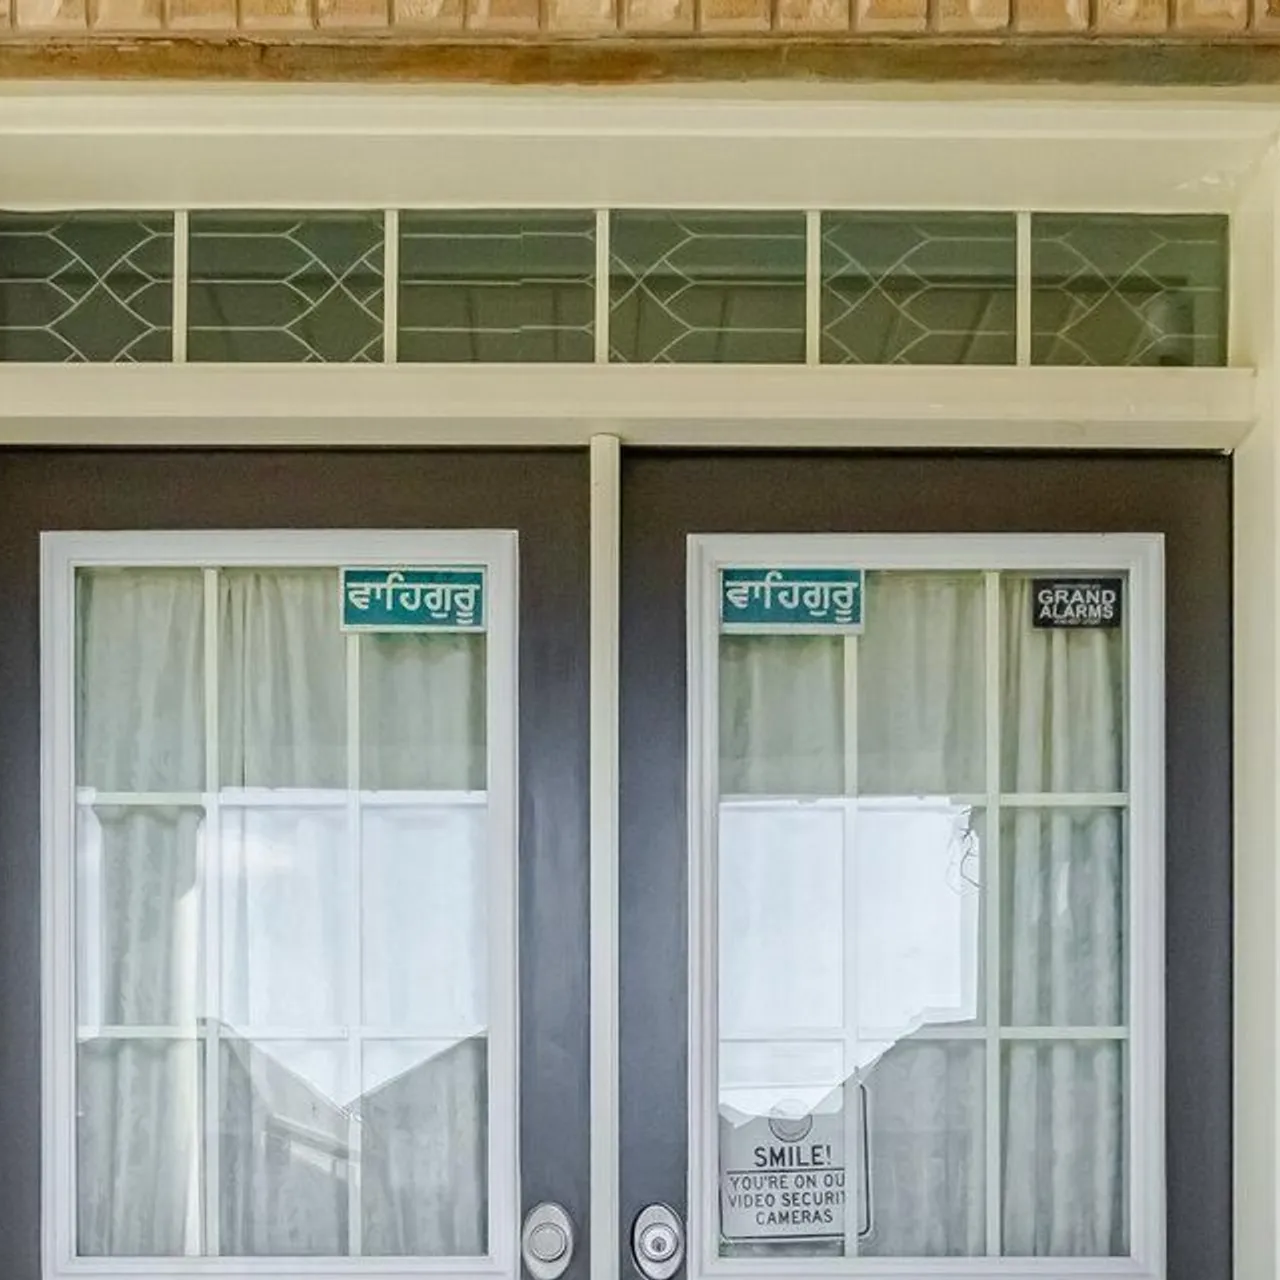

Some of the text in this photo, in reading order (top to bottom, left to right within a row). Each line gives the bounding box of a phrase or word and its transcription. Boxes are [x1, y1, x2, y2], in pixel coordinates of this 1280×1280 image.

[346, 571, 481, 625] ਵਾਹਿਗੁਰੂ
[725, 570, 859, 623] ਵਾਹਿਗੁਰੂ
[1038, 589, 1116, 604] GRAND
[1039, 603, 1114, 619] ALARMS
[754, 1145, 831, 1168] SMILE!
[729, 1172, 845, 1191] YOU'RE ON OU
[728, 1193, 776, 1207] VIDEO
[755, 1209, 833, 1225] CAMERAS
